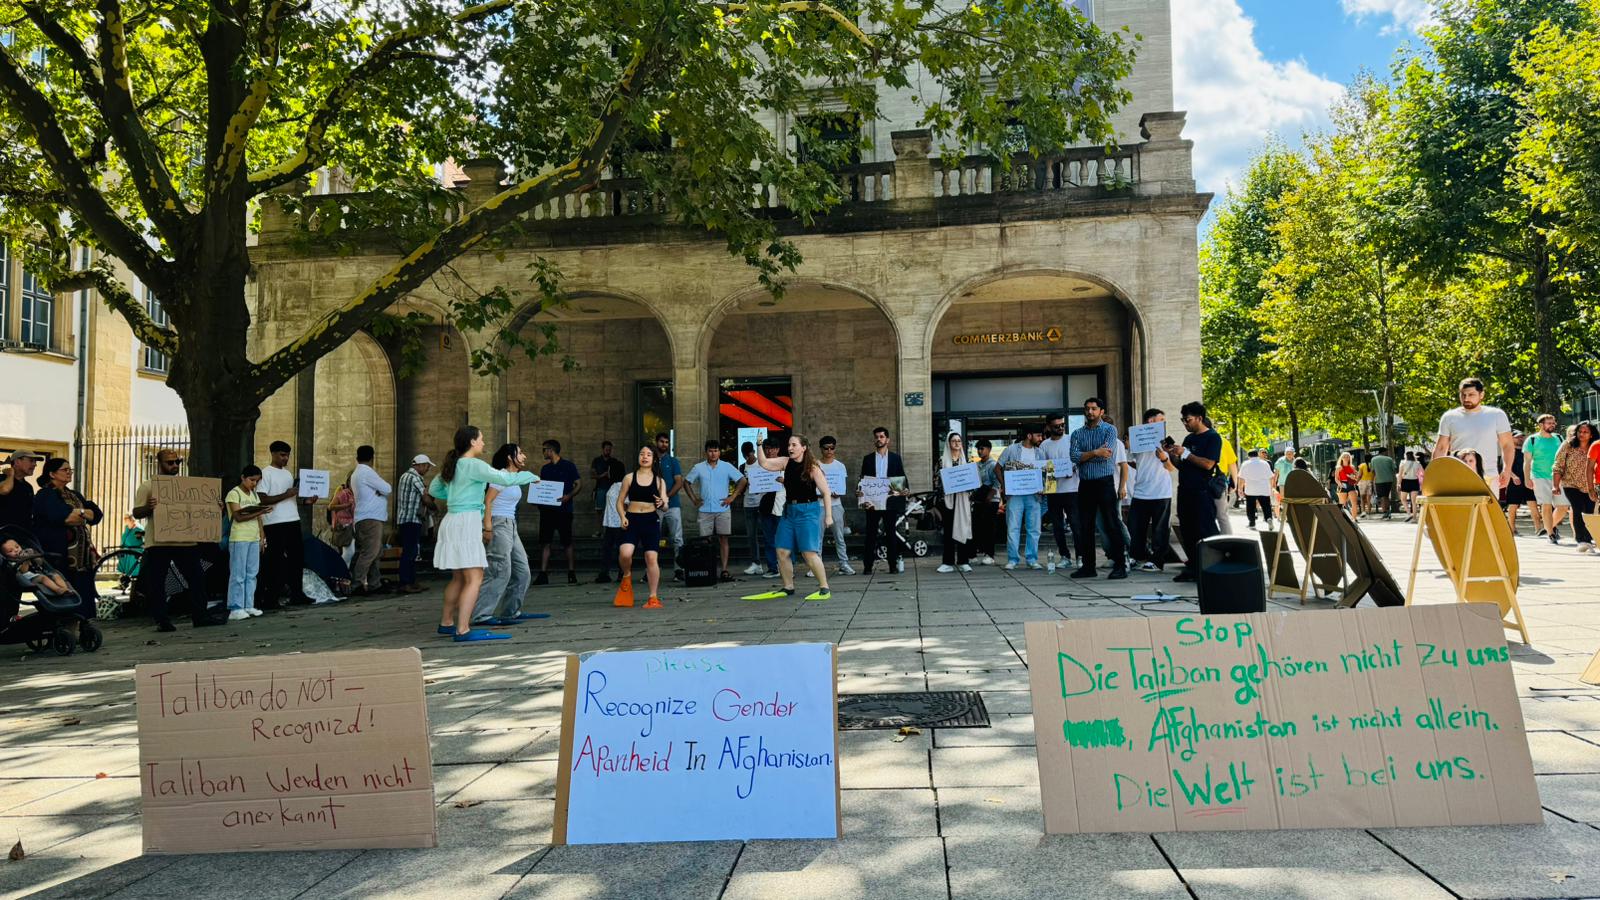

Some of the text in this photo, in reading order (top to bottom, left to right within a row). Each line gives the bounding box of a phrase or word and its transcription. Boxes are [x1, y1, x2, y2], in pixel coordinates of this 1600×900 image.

[953, 332, 1043, 345] COMMERZBANK
[1175, 617, 1253, 648] Stop
[1057, 651, 1119, 699] Die
[1106, 646, 1221, 693] Taliban
[1229, 643, 1329, 705] gehören
[1340, 640, 1404, 674] nicht
[1466, 645, 1510, 667] uns
[151, 671, 253, 718] Taliban
[260, 672, 288, 711] do
[584, 670, 799, 738] Recognize Gender
[1312, 714, 1339, 733] ist
[1349, 706, 1403, 731] nicht
[1415, 697, 1501, 731] allein.
[684, 741, 707, 771] In
[147, 757, 246, 798] Taliban
[363, 757, 416, 791] nicht
[1113, 752, 1486, 812] Die Welt ist bei uns.
